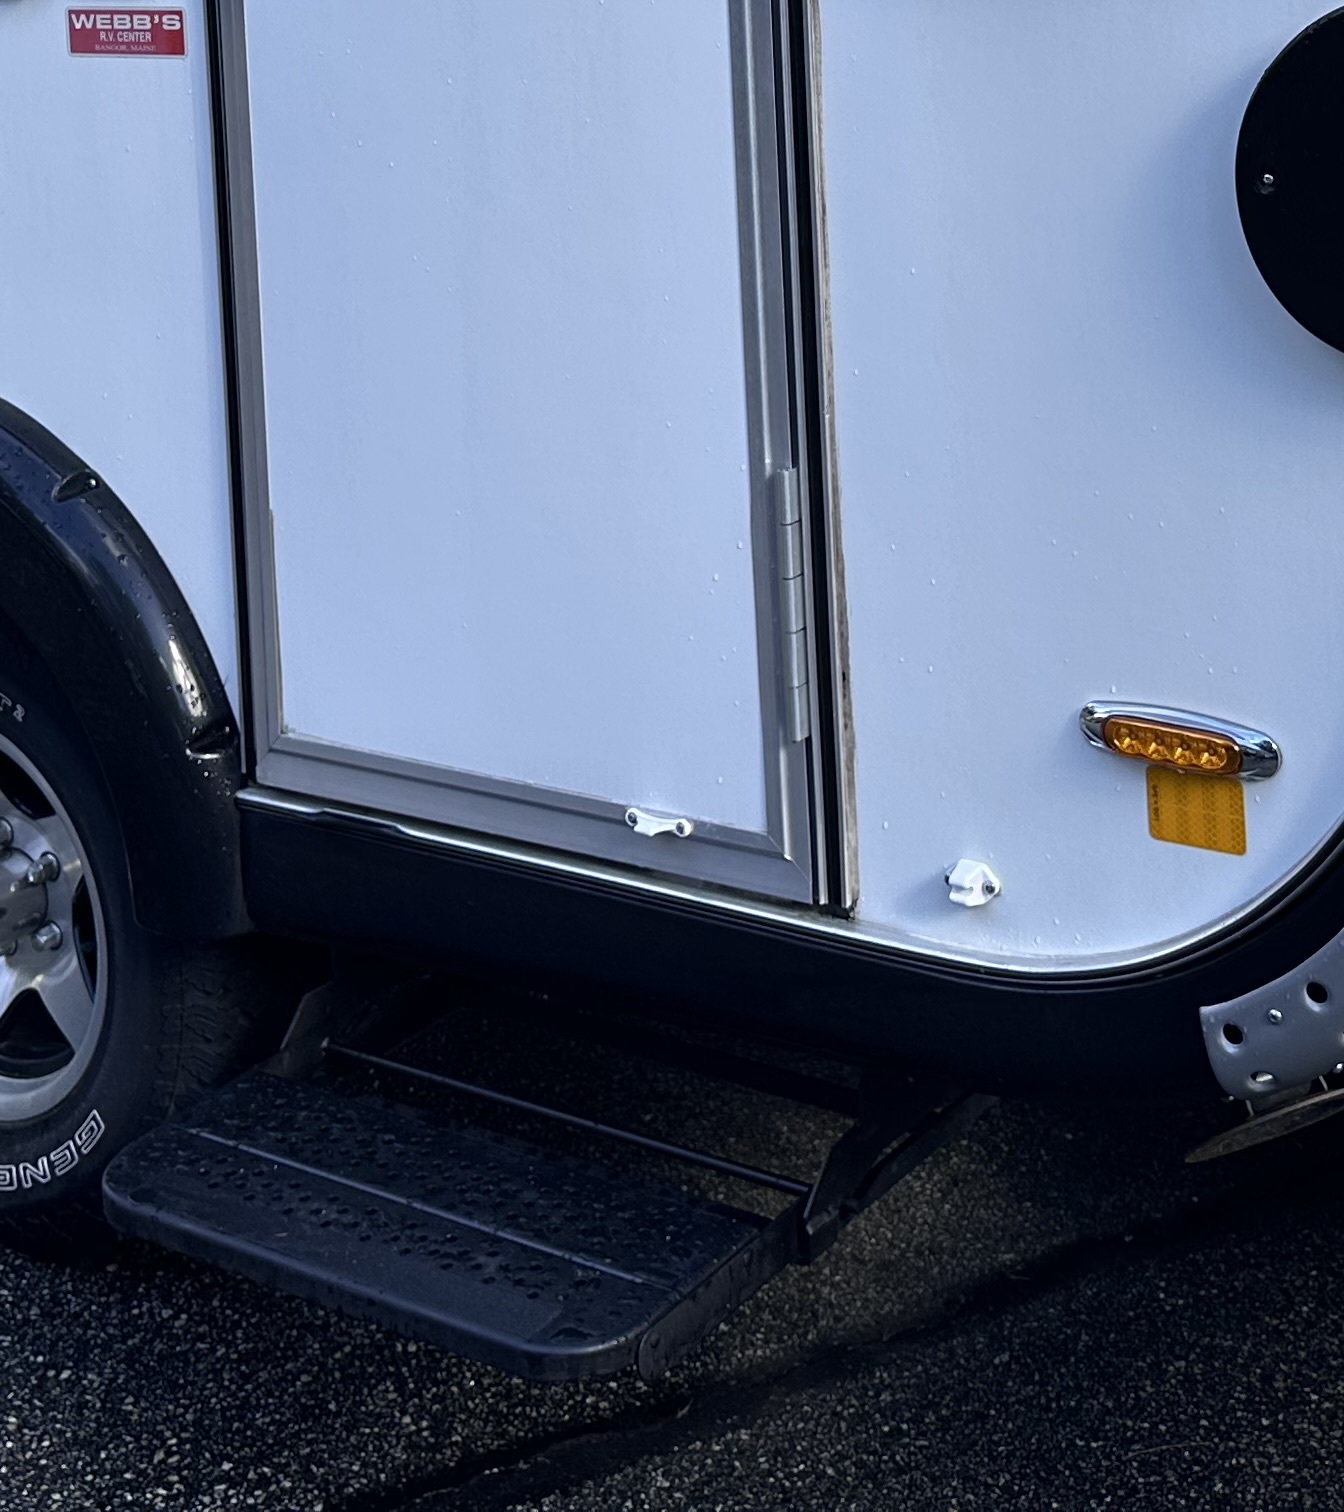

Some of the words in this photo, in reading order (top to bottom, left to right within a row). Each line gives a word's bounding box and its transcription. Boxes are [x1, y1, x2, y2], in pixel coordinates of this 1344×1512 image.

[71, 13, 182, 31] WEBB'S
[99, 31, 115, 42] R.V.
[117, 31, 152, 43] CENTER
